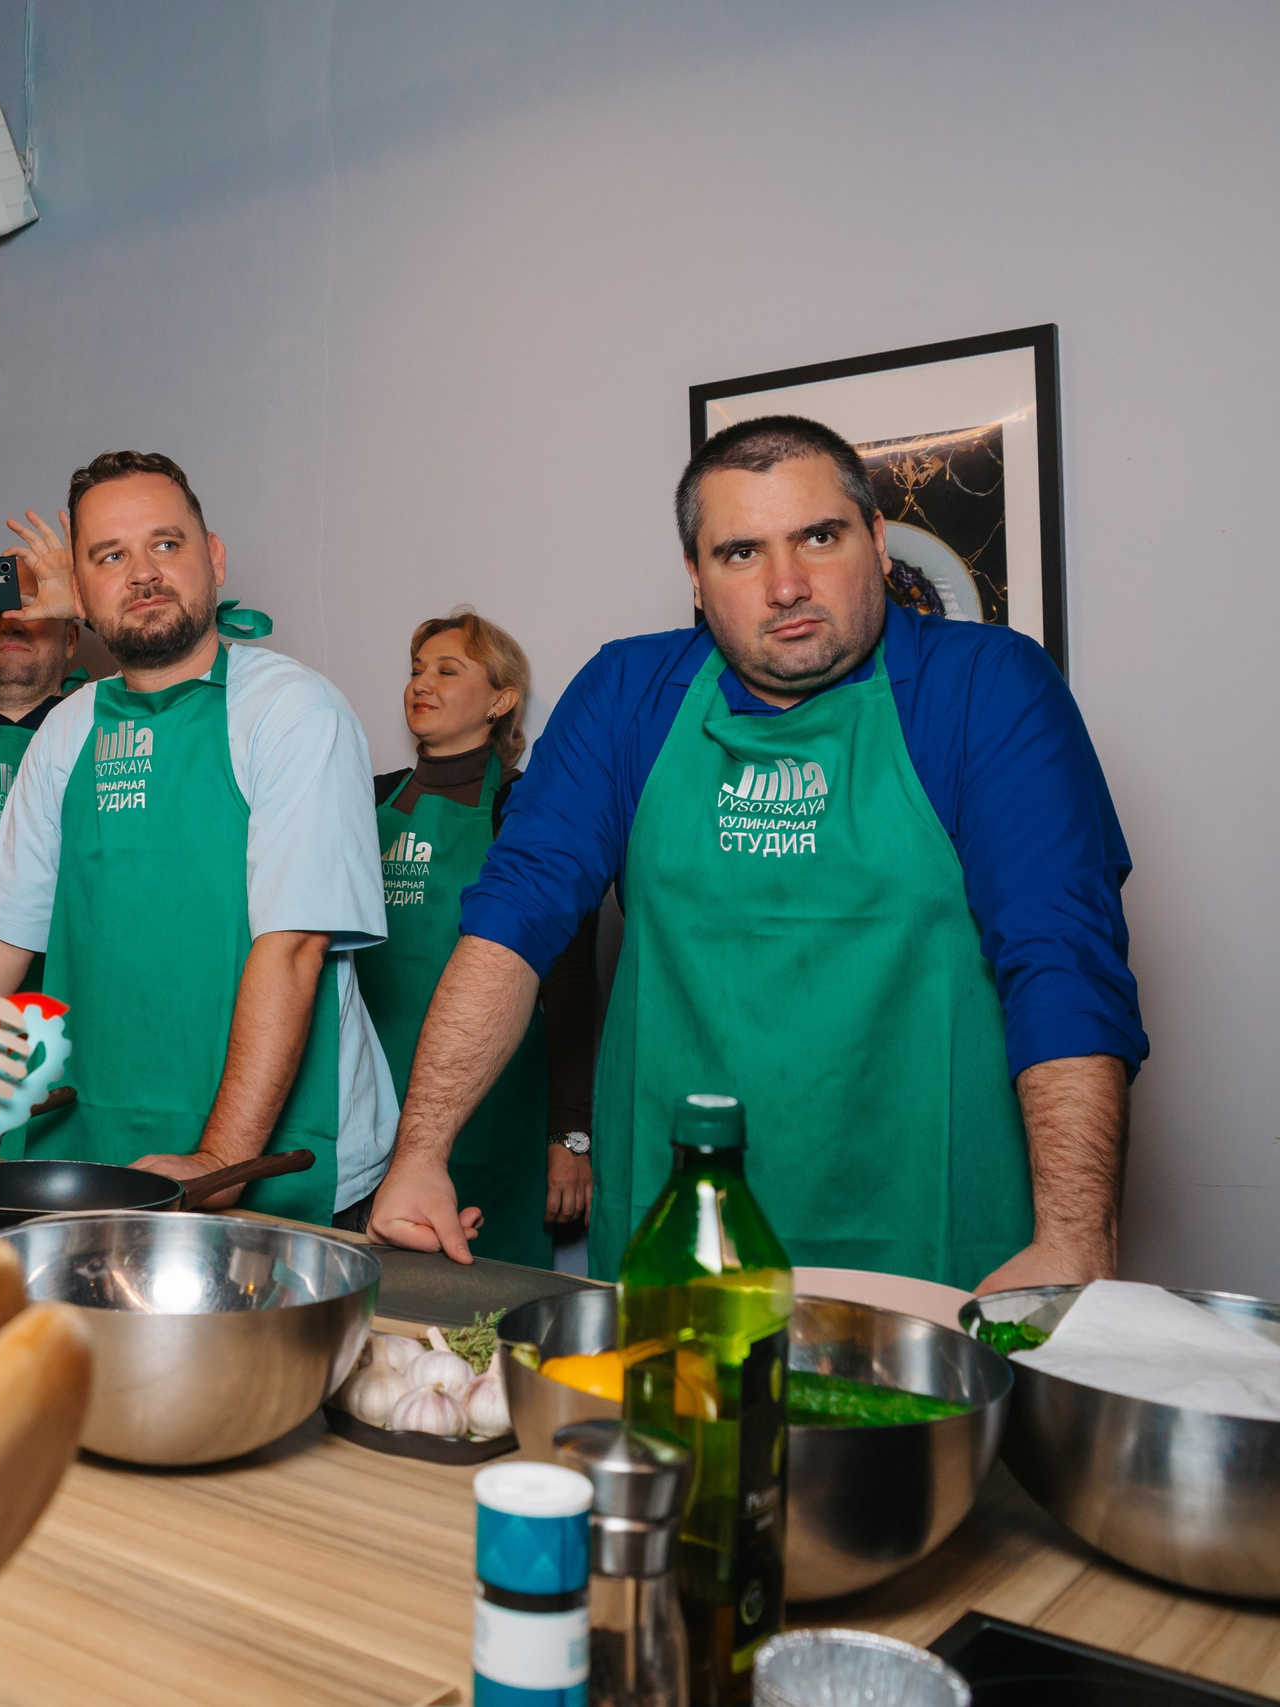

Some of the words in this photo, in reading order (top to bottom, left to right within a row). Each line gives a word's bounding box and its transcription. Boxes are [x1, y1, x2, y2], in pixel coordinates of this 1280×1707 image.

[95, 758, 152, 778] SOTSKAYA
[721, 758, 828, 801] Julia
[97, 792, 145, 812] УДИЯ
[718, 791, 825, 816] VYSOTSKAYA
[719, 816, 816, 830] КУЛИНАРНАЯ
[381, 832, 432, 862] ulia
[720, 831, 816, 857] СТУДИЯ
[382, 863, 430, 875] OTSKAYA
[383, 880, 425, 889] ИНАРНАЯ
[384, 890, 424, 906] УДИЯ
